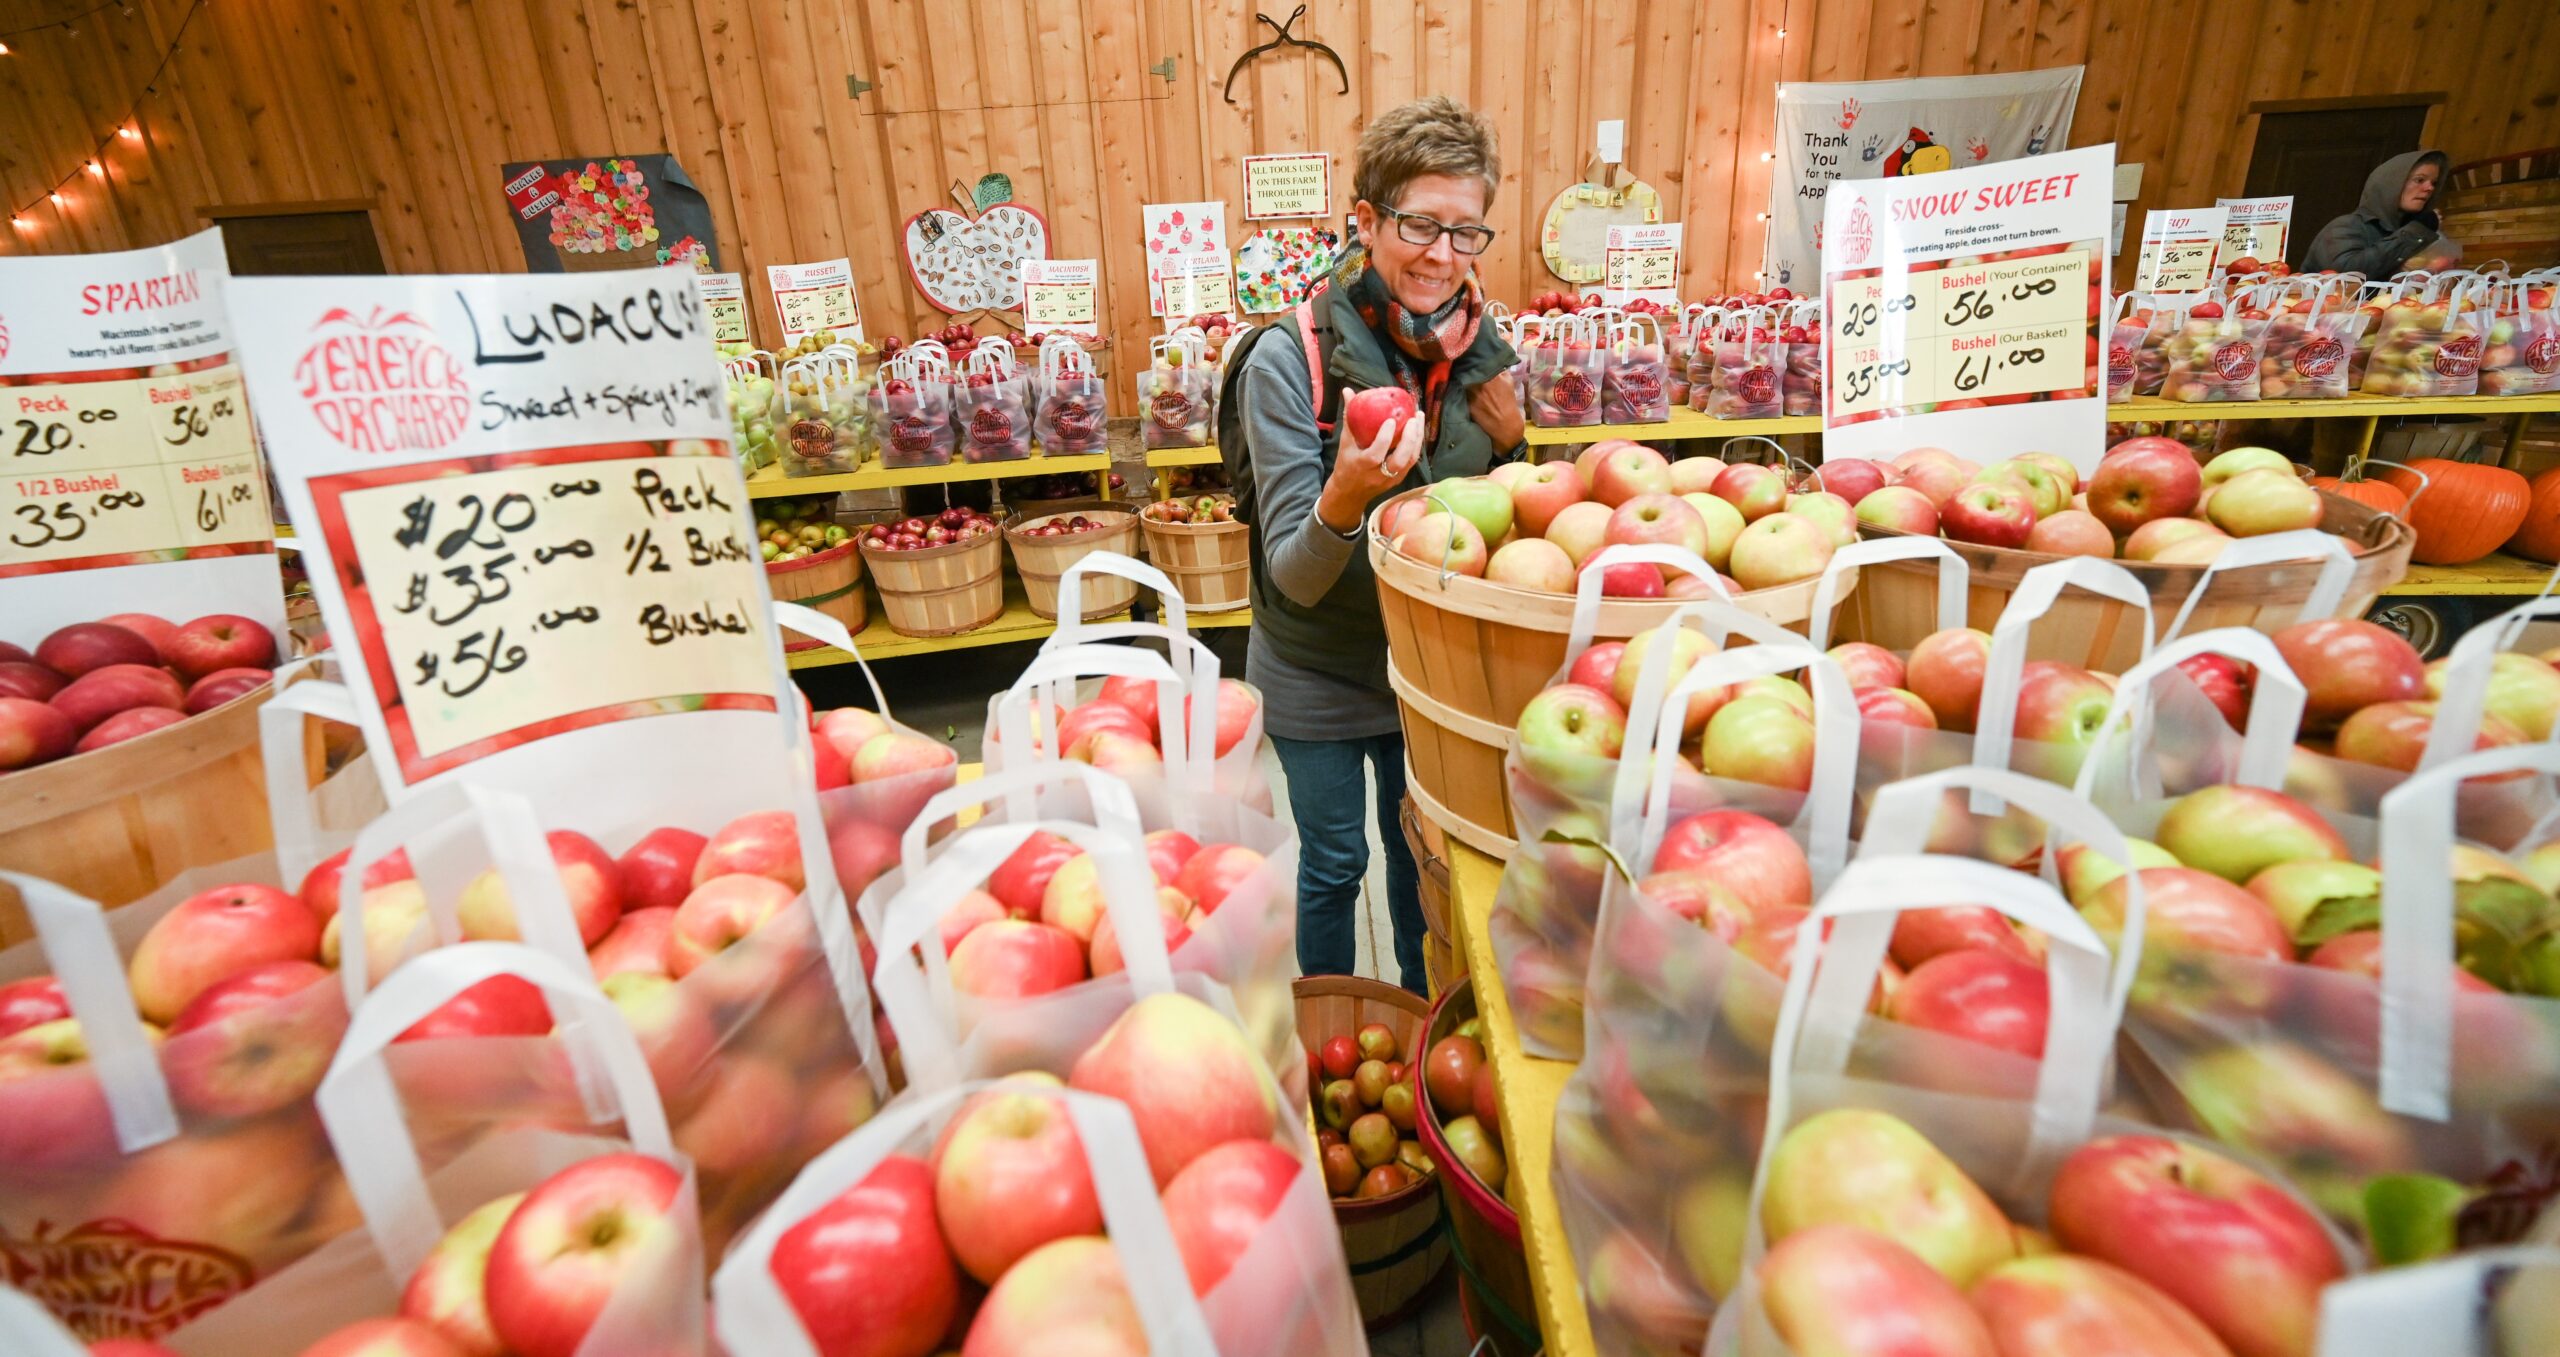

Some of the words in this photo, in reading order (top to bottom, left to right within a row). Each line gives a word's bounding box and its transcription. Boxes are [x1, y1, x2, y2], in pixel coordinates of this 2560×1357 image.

[1804, 132, 1849, 148] Thank
[1811, 152, 1838, 166] You
[1251, 166, 1268, 175] ALL
[1269, 165, 1297, 174] TOOLS
[1299, 164, 1323, 173] USED
[1805, 167, 1820, 178] for
[1824, 169, 1842, 180] the
[506, 167, 544, 196] THANKS
[1256, 178, 1270, 187] ON
[1271, 177, 1291, 186] THIS
[1292, 176, 1317, 185] FARM
[1257, 189, 1299, 198] THROUGH
[1301, 188, 1318, 196] THE
[1890, 189, 1969, 222] SNOW
[1974, 173, 2080, 212] SWEET
[1273, 200, 1303, 209] YEARS
[2258, 202, 2289, 213] CRISP
[1650, 229, 1666, 238] RED
[1920, 242, 1944, 253] eating
[1945, 239, 1970, 251] apple,
[1971, 235, 1991, 246] does
[1993, 232, 2008, 243] not
[2009, 231, 2028, 241] turn
[2029, 226, 2061, 238] brown.
[1945, 225, 1977, 237] Fireside
[1048, 265, 1090, 273] MACINTOSH
[1184, 255, 1220, 265] CRTLAND
[804, 266, 837, 278] RUSSETT
[1942, 271, 1986, 290] Bushel
[1989, 270, 2019, 282] (Your
[2021, 261, 2082, 278] Container)
[700, 278, 729, 287] SHIZUKA
[82, 269, 200, 316] SPARTAN
[1866, 285, 1883, 299] Pec
[1944, 278, 2056, 327] 56.00
[1952, 334, 1996, 352] Bushel
[1999, 332, 2024, 345] (Our
[2026, 328, 2068, 342] Basket)
[1854, 350, 1868, 363] 1/2
[1954, 347, 2045, 391] 61.00
[18, 395, 69, 414] Peck
[150, 387, 192, 405] Bushel
[480, 386, 580, 432] Sweet
[602, 385, 677, 427] Spicy
[311, 392, 472, 453] ORCHARD
[182, 465, 221, 483] Bushel
[16, 479, 50, 497] 1/2
[54, 473, 120, 495] Bushel
[633, 466, 732, 518] Peck
[10, 491, 145, 548] 35.00
[625, 528, 671, 576] 1/2
[638, 600, 754, 646] Bushel
